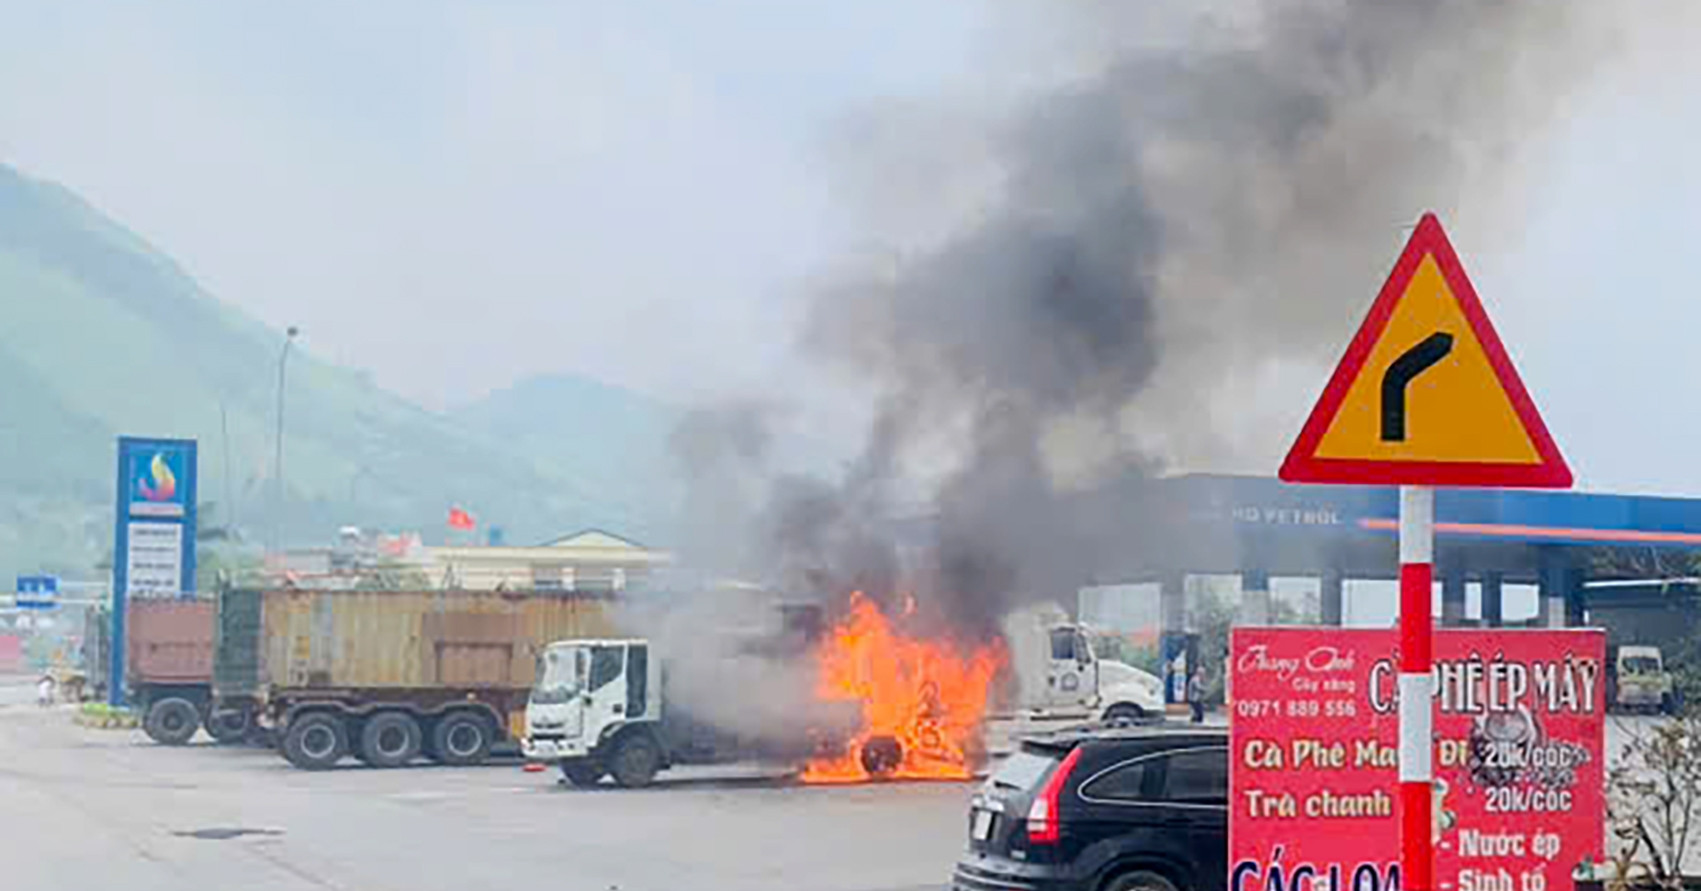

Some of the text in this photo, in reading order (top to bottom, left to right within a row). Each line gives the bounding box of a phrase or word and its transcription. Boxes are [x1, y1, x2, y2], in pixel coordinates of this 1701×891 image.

[1489, 648, 1528, 712] ÉP
[1533, 653, 1599, 714] MÁY
[1238, 700, 1281, 717] 0971
[1244, 739, 1283, 768] Cà
[1292, 739, 1346, 768] Phê
[1354, 739, 1398, 768] Ma
[1244, 789, 1392, 818] Trà chanh
[1458, 827, 1561, 861] Nước ép
